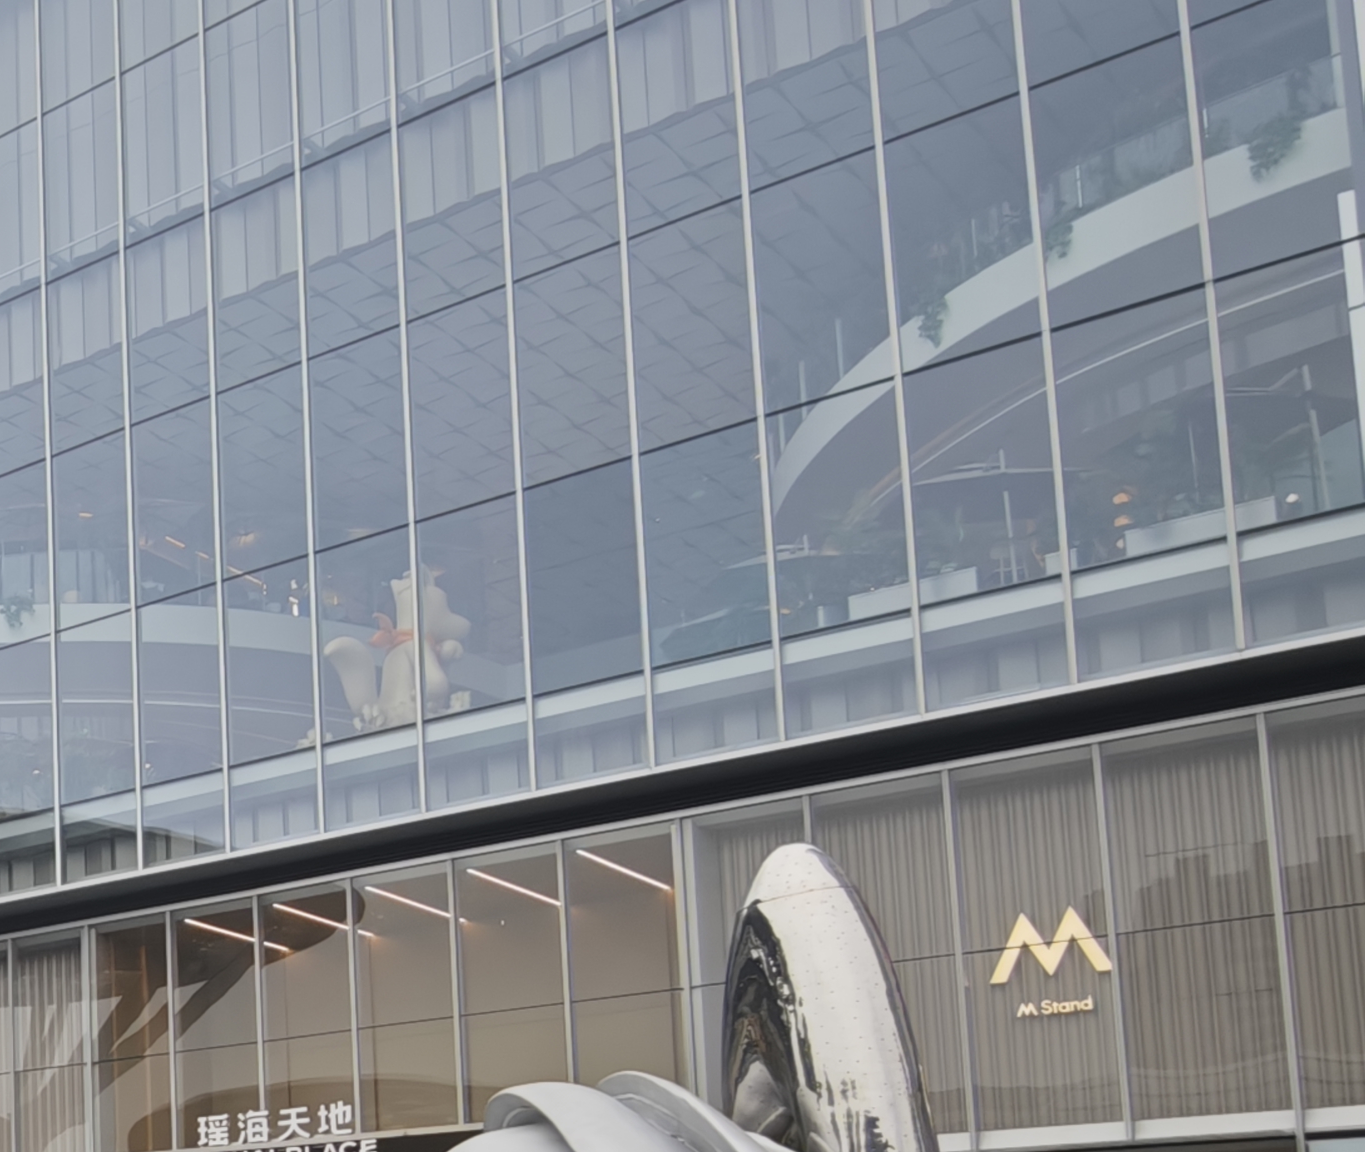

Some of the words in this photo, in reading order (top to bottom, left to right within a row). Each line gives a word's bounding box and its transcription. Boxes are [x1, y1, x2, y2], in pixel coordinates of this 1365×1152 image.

[1016, 1002, 1039, 1018] M
[1040, 994, 1094, 1015] Stand
[196, 1100, 353, 1147] 瑶海天地
